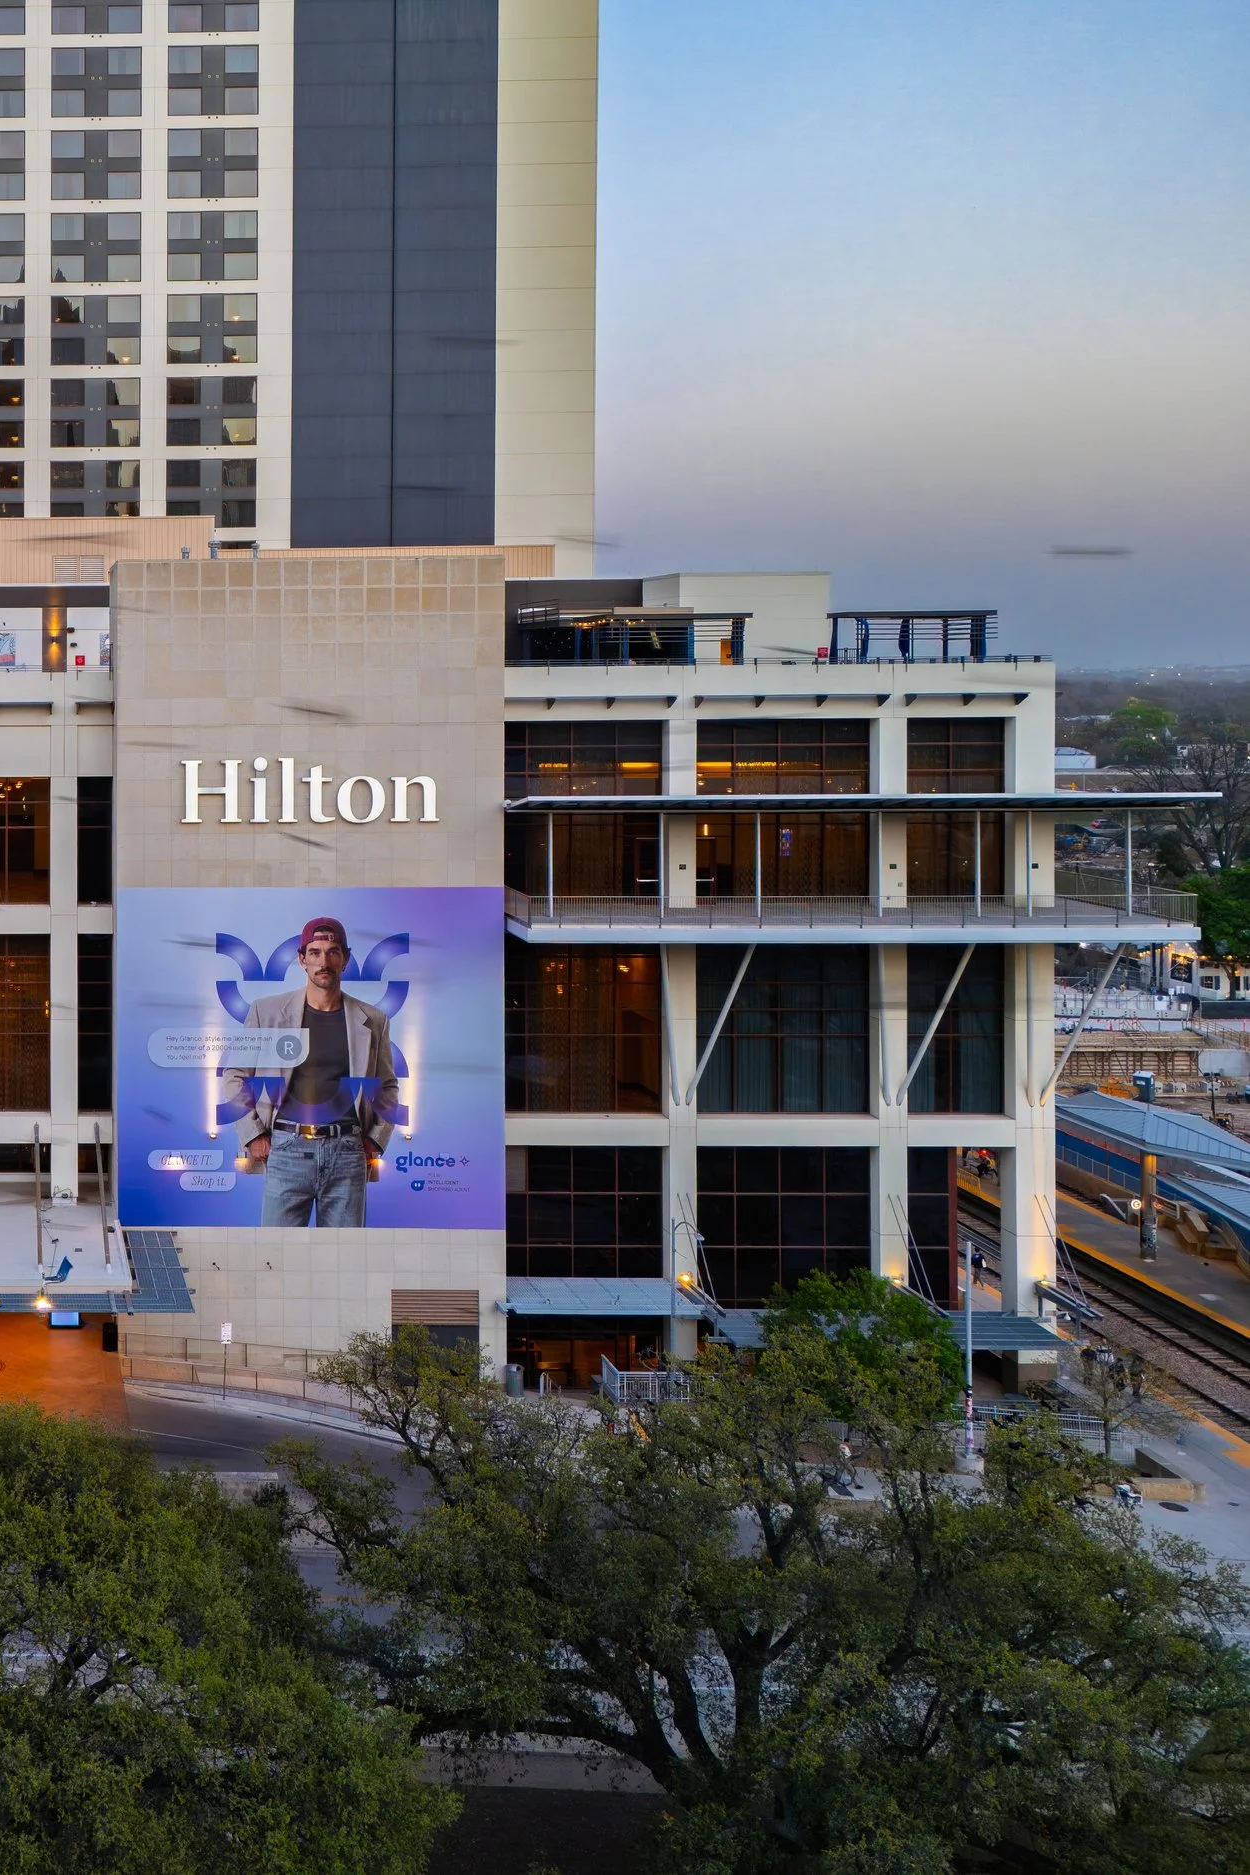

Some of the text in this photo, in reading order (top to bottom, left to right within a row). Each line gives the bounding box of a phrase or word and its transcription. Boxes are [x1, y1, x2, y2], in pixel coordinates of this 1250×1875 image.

[181, 756, 440, 824] Hilton
[284, 1041, 294, 1055] R
[395, 1151, 456, 1173] glance
[191, 1175, 215, 1189] Shop
